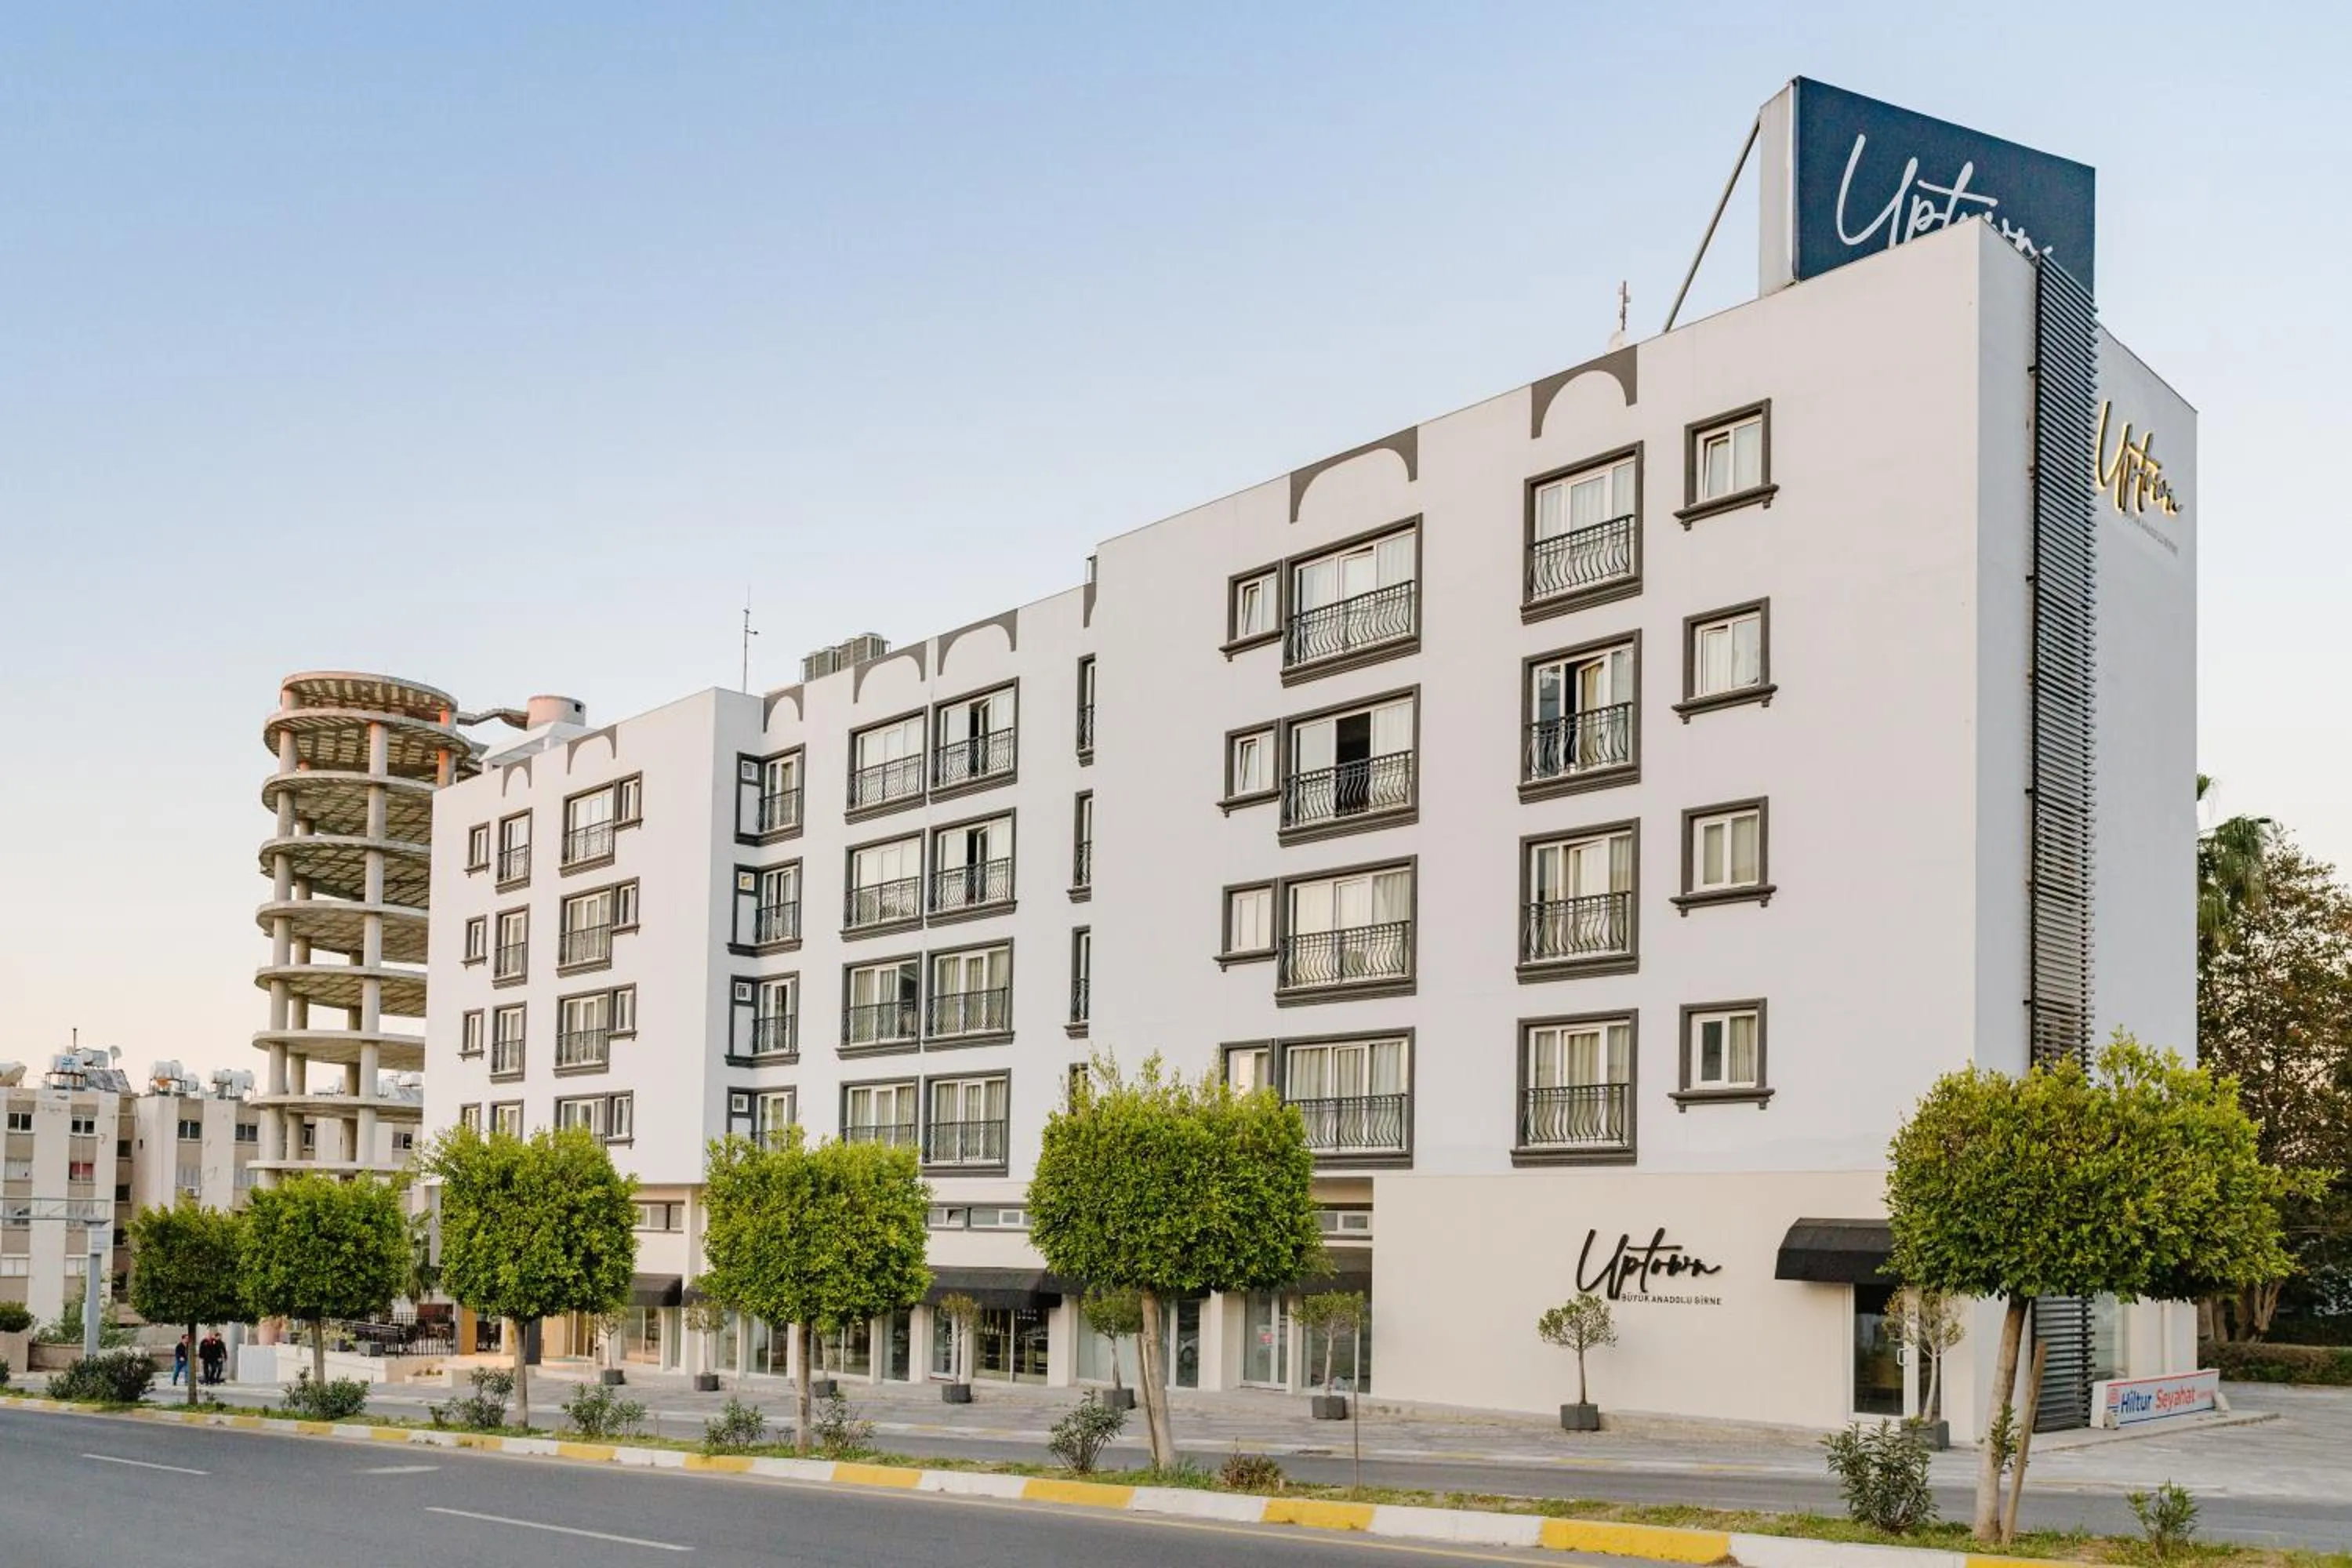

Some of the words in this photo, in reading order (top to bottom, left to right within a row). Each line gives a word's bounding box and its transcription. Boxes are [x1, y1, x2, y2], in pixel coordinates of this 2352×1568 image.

[1576, 1227, 1722, 1301] Uptown
[1651, 1294, 1693, 1305] ANADOLU
[2120, 1389, 2153, 1414] Hiltur
[2155, 1385, 2196, 1411] Seyahat
